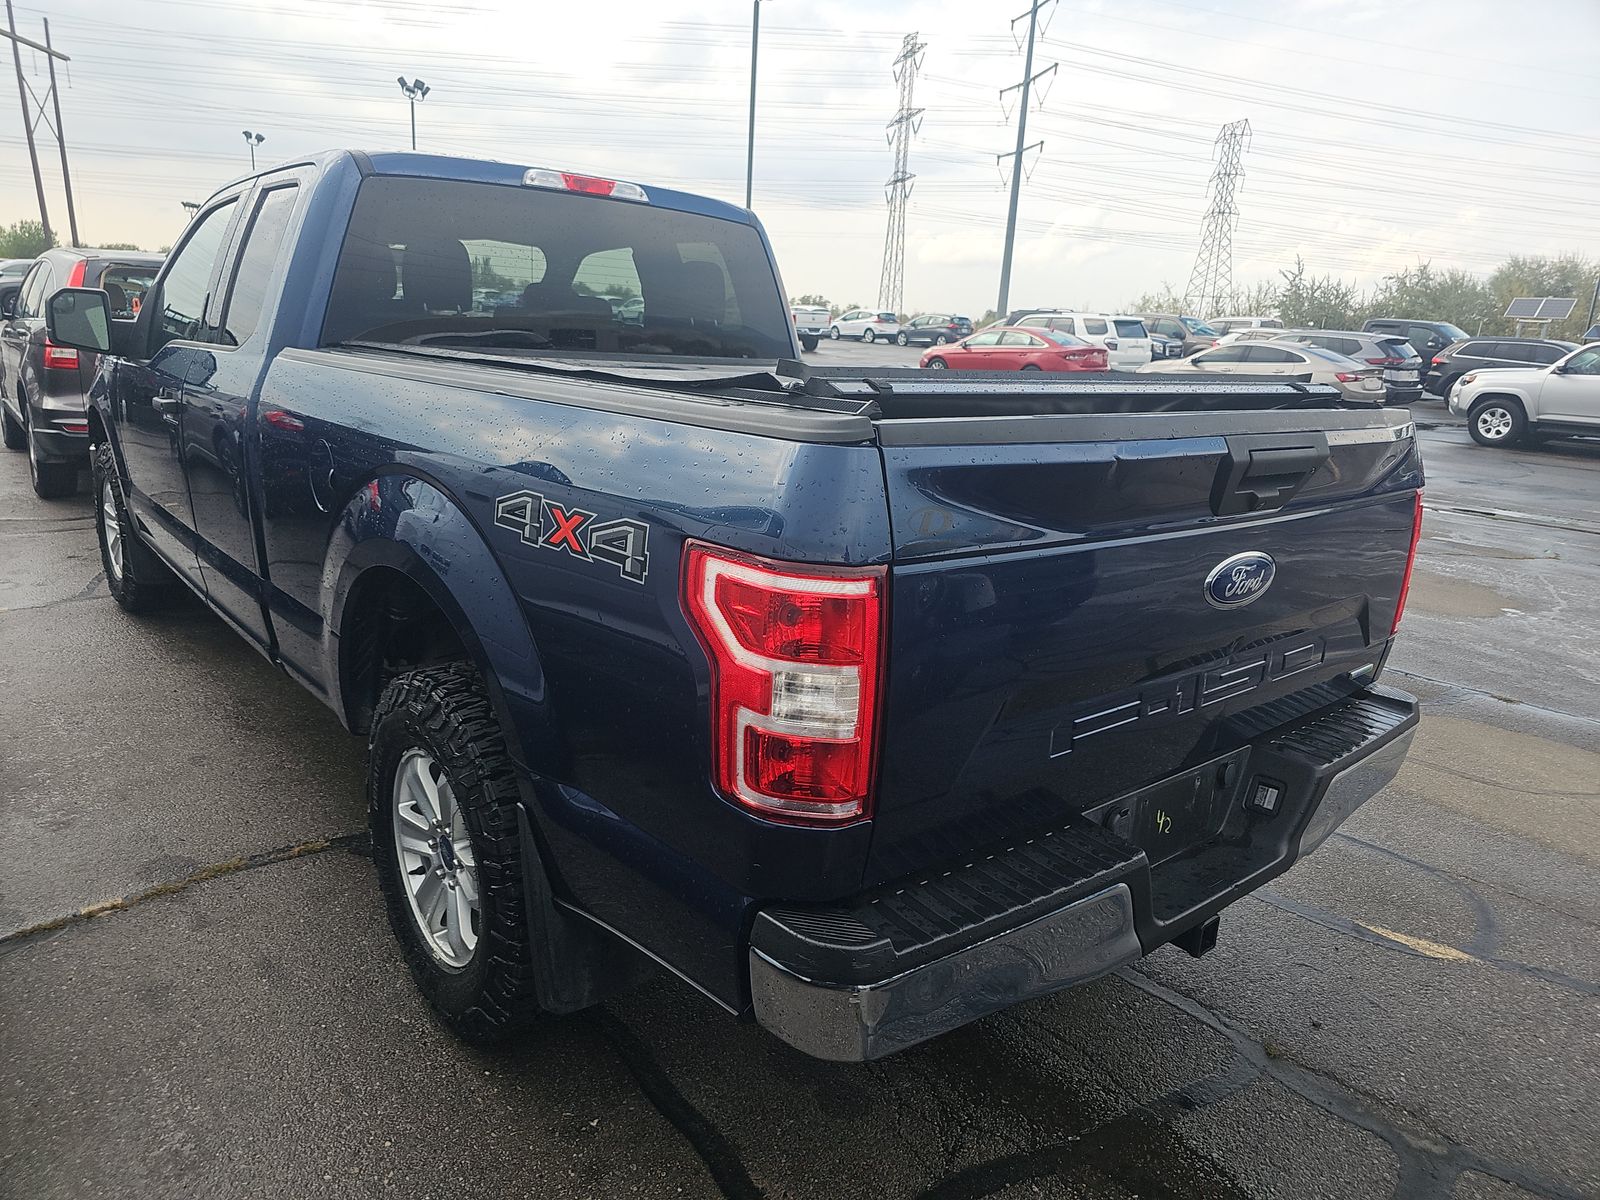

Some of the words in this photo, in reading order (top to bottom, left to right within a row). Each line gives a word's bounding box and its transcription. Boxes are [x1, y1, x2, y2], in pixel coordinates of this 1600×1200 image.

[1225, 564, 1266, 598] Ford
[1049, 636, 1327, 760] F-150
[1156, 809, 1172, 835] 42
